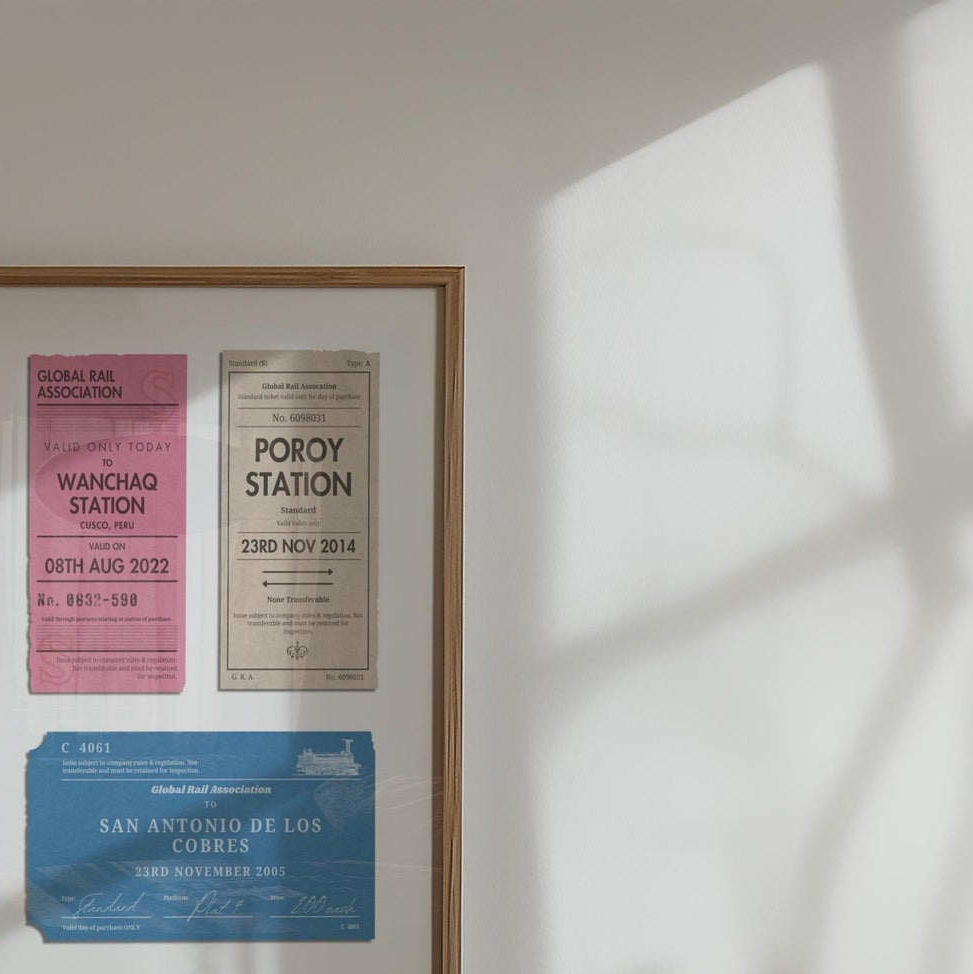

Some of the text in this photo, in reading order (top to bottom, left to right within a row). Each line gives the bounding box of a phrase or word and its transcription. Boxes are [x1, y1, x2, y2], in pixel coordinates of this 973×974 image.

[38, 370, 115, 382] GLOBAL RAIL
[37, 386, 122, 399] ASSOCIATION
[272, 413, 325, 422] No. 6098031
[44, 442, 171, 453] VALID ONLY TODAY
[255, 437, 344, 463] POROY
[102, 459, 113, 467] TO
[57, 472, 157, 491] WANCHAQ
[246, 471, 351, 497] STATION
[70, 496, 145, 514] STATION
[281, 506, 316, 514] Standard
[80, 521, 134, 530] CUSCO, PERU
[89, 542, 125, 550] VALID ON
[241, 539, 355, 553] 23RD NOV 2014
[45, 558, 169, 574] 08TH AUG 2022
[38, 593, 59, 607] No.
[62, 742, 110, 753] C 4061
[151, 785, 271, 794] Global Rail Association
[100, 818, 321, 833] SAN ANTONIO DE LOS
[173, 838, 249, 853] COBRES
[136, 866, 285, 877] 23RD NOVEMBER 2005
